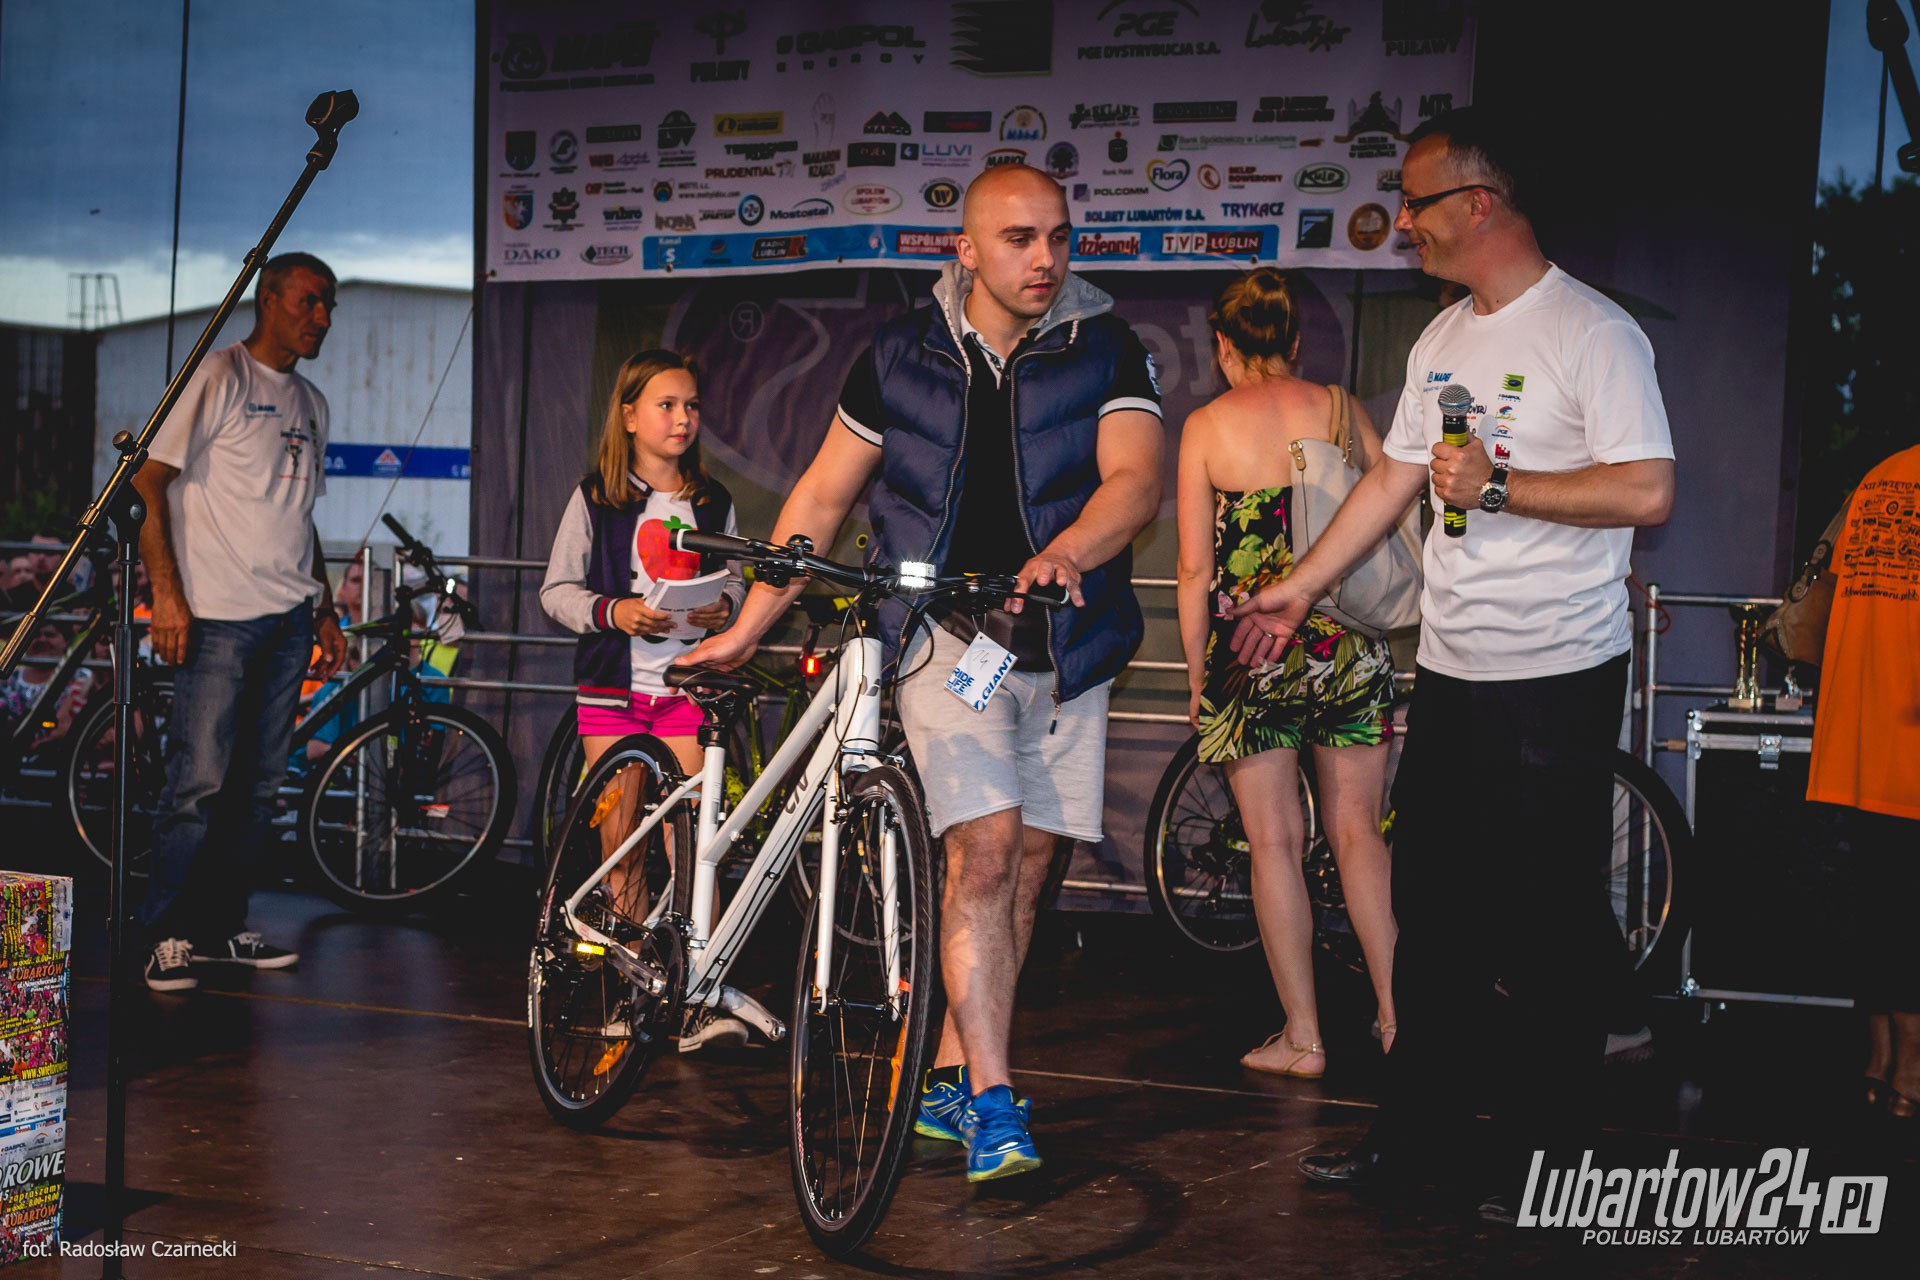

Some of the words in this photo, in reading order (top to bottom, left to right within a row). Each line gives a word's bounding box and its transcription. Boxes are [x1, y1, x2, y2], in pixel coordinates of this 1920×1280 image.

[1114, 11, 1178, 37] PGE
[1077, 46, 1103, 60] PGE
[1104, 42, 1194, 58] DYSTRYBUCJA
[1196, 42, 1221, 55] S.A.
[921, 144, 972, 156] LUVI
[705, 166, 776, 179] PRUDENTIAL
[1152, 167, 1183, 181] Flora
[1228, 166, 1257, 174] SKLEP
[1228, 174, 1283, 183] ROWEROWY
[1094, 187, 1149, 196] POLCOMM
[769, 206, 830, 220] Mostostal
[1127, 207, 1183, 222] LUBARTÓW
[1210, 236, 1260, 250] LUBLIN
[503, 248, 561, 261] DAKO
[755, 247, 787, 258] LUBLIN
[952, 667, 975, 687] RIDE
[982, 653, 1013, 700] GIANT
[947, 678, 968, 693] LIFE
[12, 961, 64, 983] LUBARTÓW
[8, 1183, 62, 1204] zapraszamy
[5, 1203, 58, 1229] LUBARTÓW
